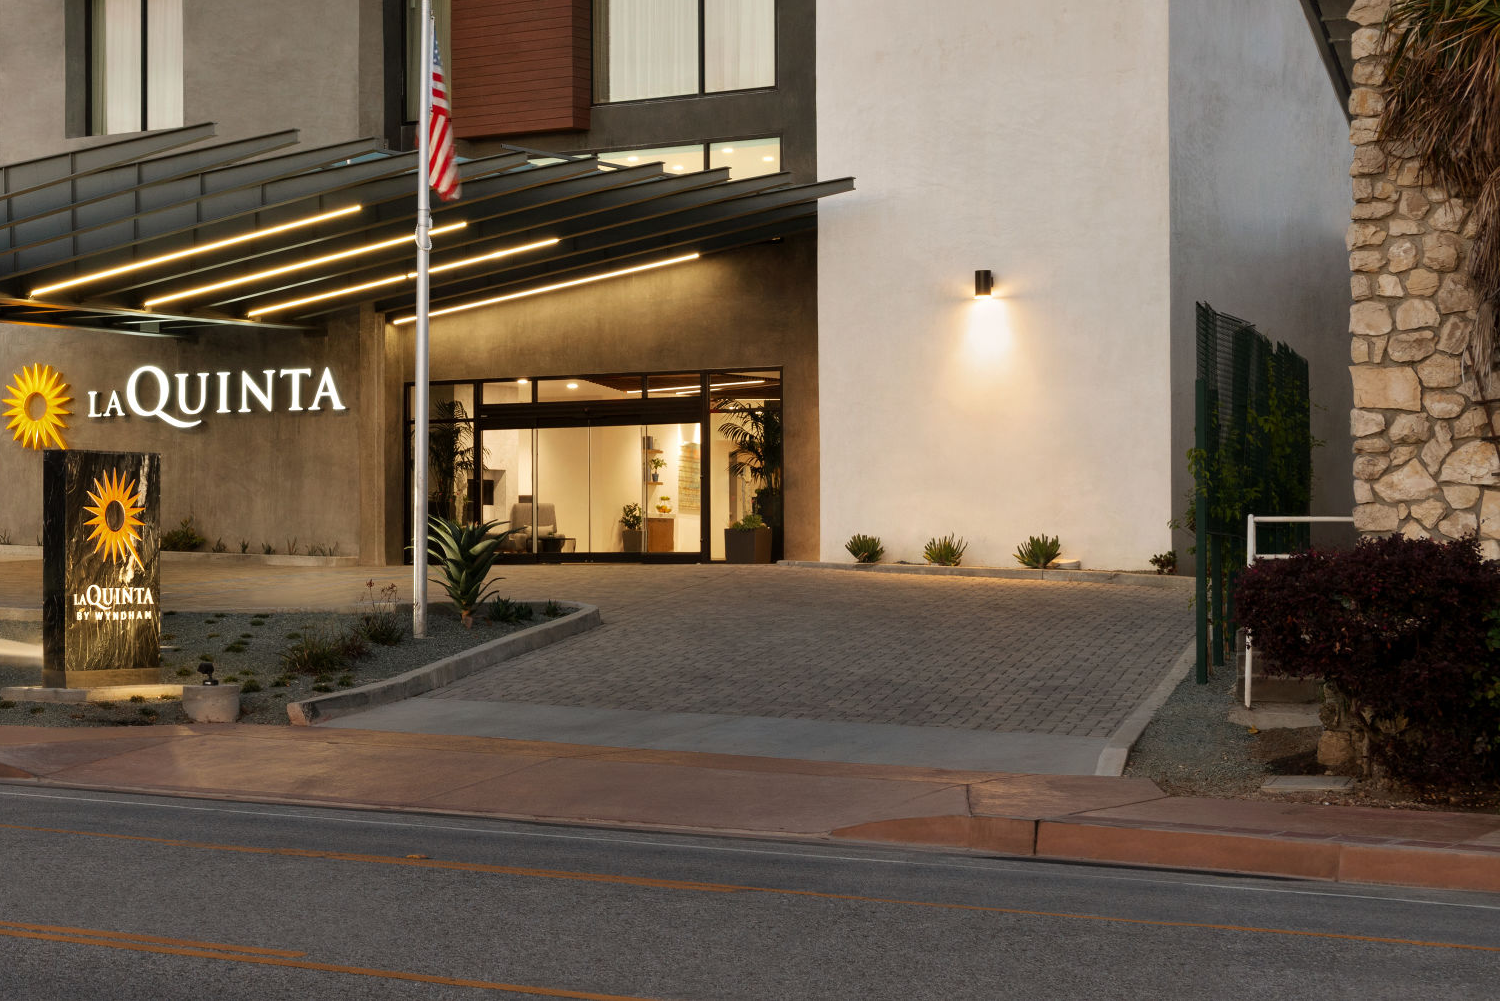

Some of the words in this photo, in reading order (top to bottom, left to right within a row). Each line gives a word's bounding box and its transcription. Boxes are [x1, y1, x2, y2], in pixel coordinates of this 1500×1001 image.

[87, 390, 125, 418] LA
[126, 365, 346, 429] QUINTA
[74, 593, 86, 606] LA
[86, 584, 155, 610] QUINTA
[76, 611, 89, 621] BY
[95, 610, 152, 621] WYNDHAM
